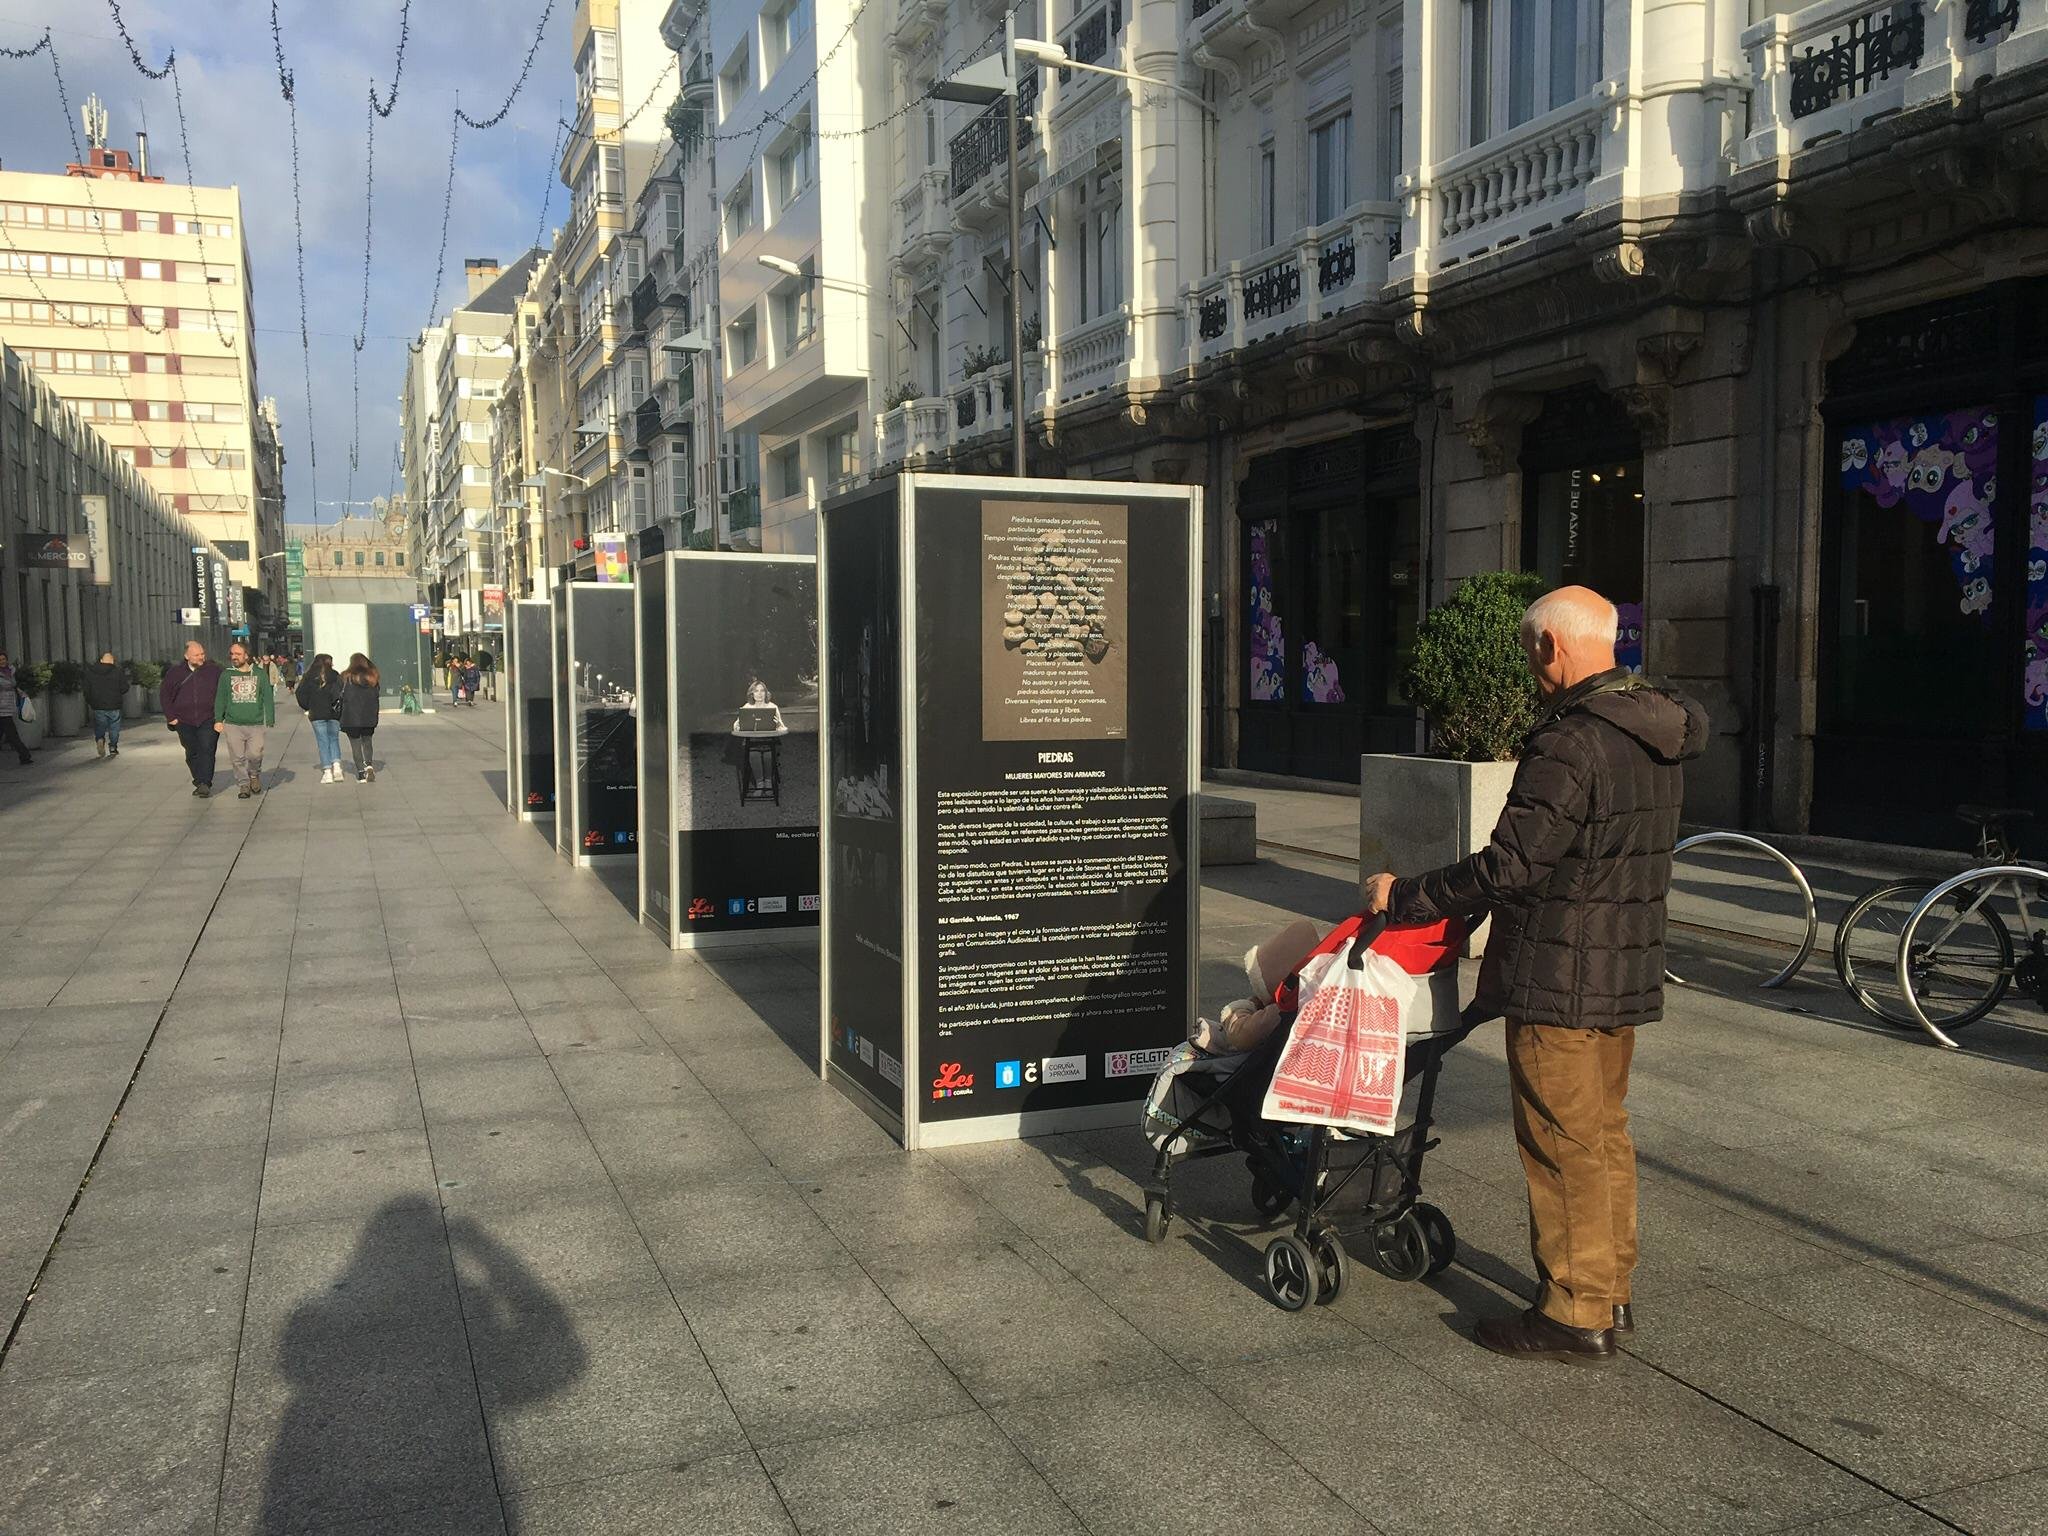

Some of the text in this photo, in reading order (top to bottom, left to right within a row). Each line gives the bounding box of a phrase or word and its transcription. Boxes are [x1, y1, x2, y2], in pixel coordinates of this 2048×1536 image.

[1034, 516, 1060, 524] formadas
[38, 552, 86, 560] MERCATO
[196, 556, 204, 576] LUGO
[198, 578, 205, 588] DE
[414, 609, 426, 620] P
[1016, 687, 1037, 696] piedras
[1029, 697, 1052, 706] mujeres
[1070, 715, 1092, 724] piedras.
[1038, 752, 1074, 764] PIEDRAS
[951, 789, 980, 799] exposición
[982, 789, 1008, 798] pretende
[1057, 787, 1084, 796] homenaje
[1136, 785, 1157, 794] mujeres
[1005, 796, 1020, 805] largo
[1138, 792, 1168, 800] lesbofobia,
[982, 821, 1003, 830] lugares
[1019, 819, 1046, 827] sociedad,
[1081, 818, 1100, 827] trabajo
[977, 828, 1009, 837] constituido
[1083, 825, 1120, 835] generaciones,
[1122, 823, 1160, 832] demostrando,
[938, 846, 969, 856] rresponde.
[938, 895, 960, 904] empleo
[1036, 890, 1073, 898] contrastadas,
[1089, 887, 1118, 895] accidental.
[949, 915, 975, 923] Garrido.
[976, 914, 1003, 922] Valencia,
[938, 949, 957, 958] grafía.
[938, 988, 968, 996] asociación
[969, 986, 988, 994] Amunt
[933, 1063, 974, 1088] Les
